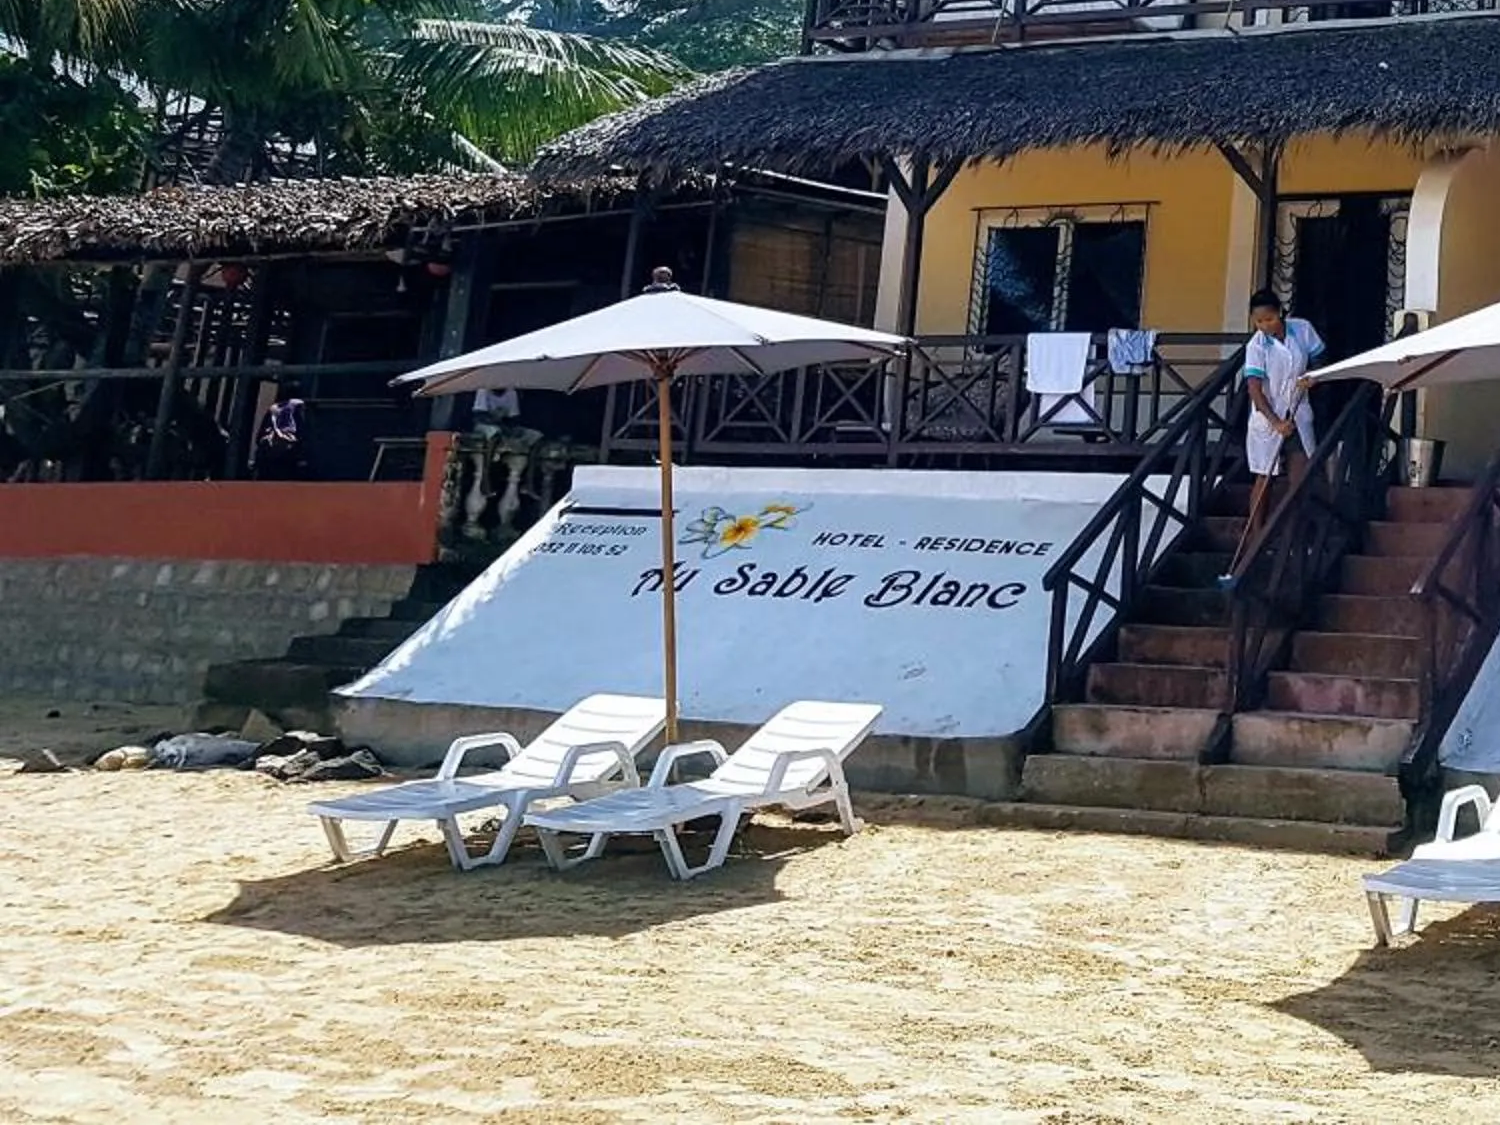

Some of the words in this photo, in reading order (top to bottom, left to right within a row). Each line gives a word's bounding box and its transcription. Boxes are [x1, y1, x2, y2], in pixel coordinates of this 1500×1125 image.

[812, 532, 885, 548] HOTEL
[913, 536, 1054, 557] RESIDENCE
[713, 562, 855, 604] Sable
[863, 569, 1027, 609] Blanc
